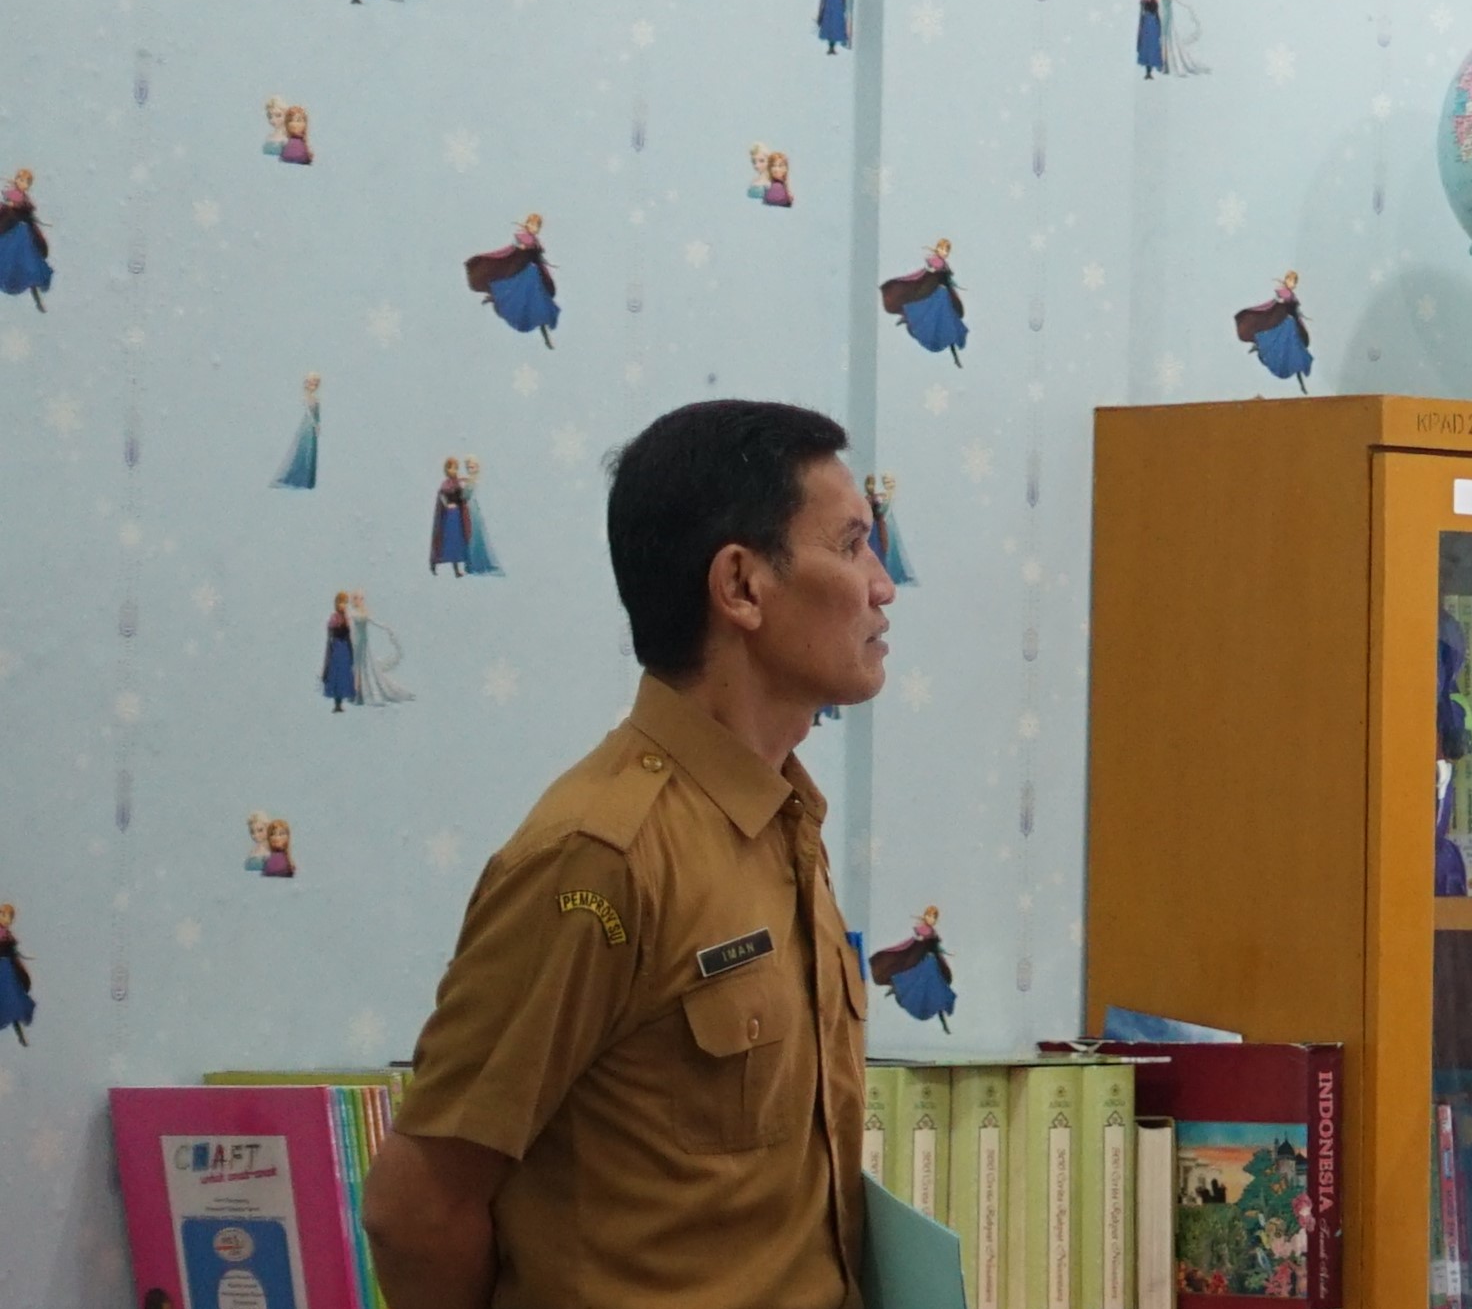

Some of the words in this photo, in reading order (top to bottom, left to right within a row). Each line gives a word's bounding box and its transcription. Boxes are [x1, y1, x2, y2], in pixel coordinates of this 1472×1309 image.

[1416, 412, 1464, 435] KPAD
[721, 943, 755, 962] IMAN
[1319, 1070, 1334, 1213] INDONESIA
